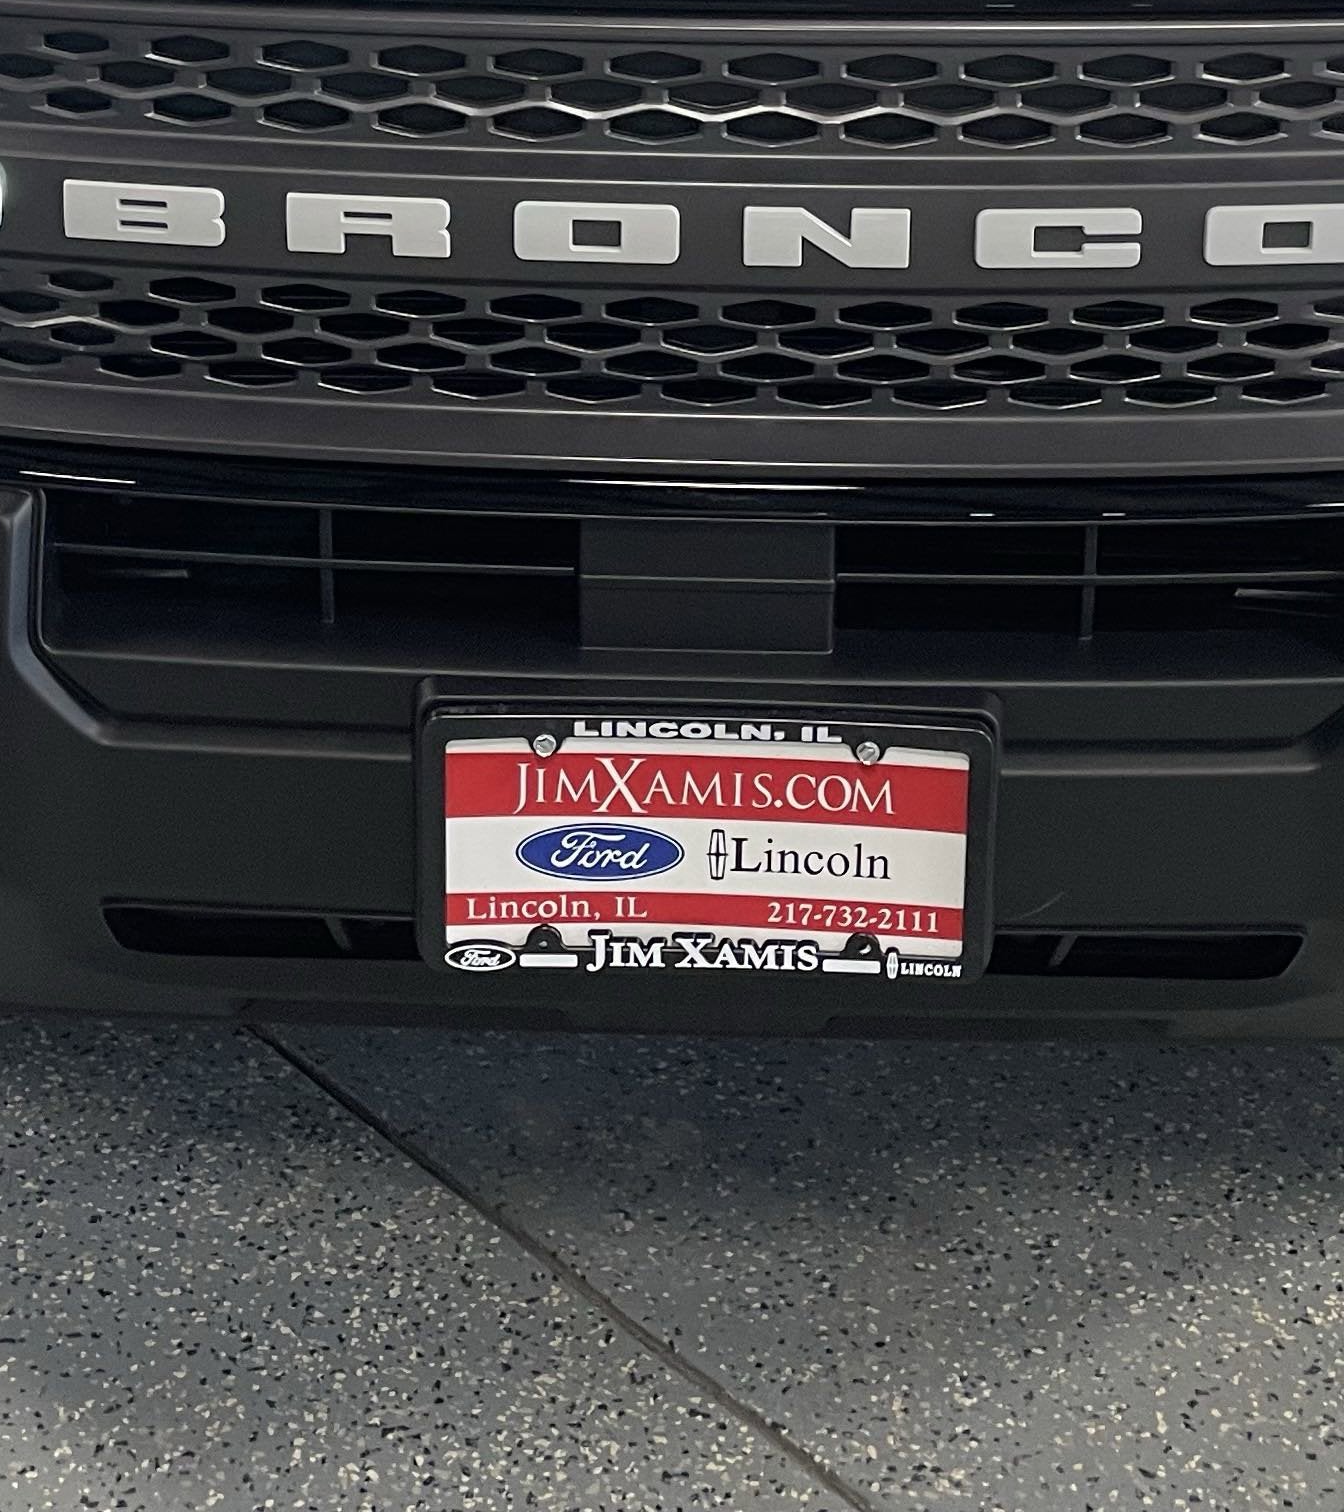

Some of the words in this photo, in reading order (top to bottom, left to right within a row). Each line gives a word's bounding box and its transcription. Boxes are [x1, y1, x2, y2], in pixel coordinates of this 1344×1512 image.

[574, 721, 786, 742] LINCOLN,
[802, 725, 843, 744] IL
[512, 756, 896, 816] JIMXAMIS.COM
[550, 830, 649, 871] Ford
[731, 837, 892, 881] Lincoln
[467, 894, 601, 921] Lincoln,
[614, 895, 648, 918] IL
[767, 901, 940, 933] 217-732-2111
[460, 949, 501, 967] Ford
[586, 932, 665, 972] JIM
[674, 939, 818, 972] XAMIS
[900, 962, 962, 978] LINCOLN
